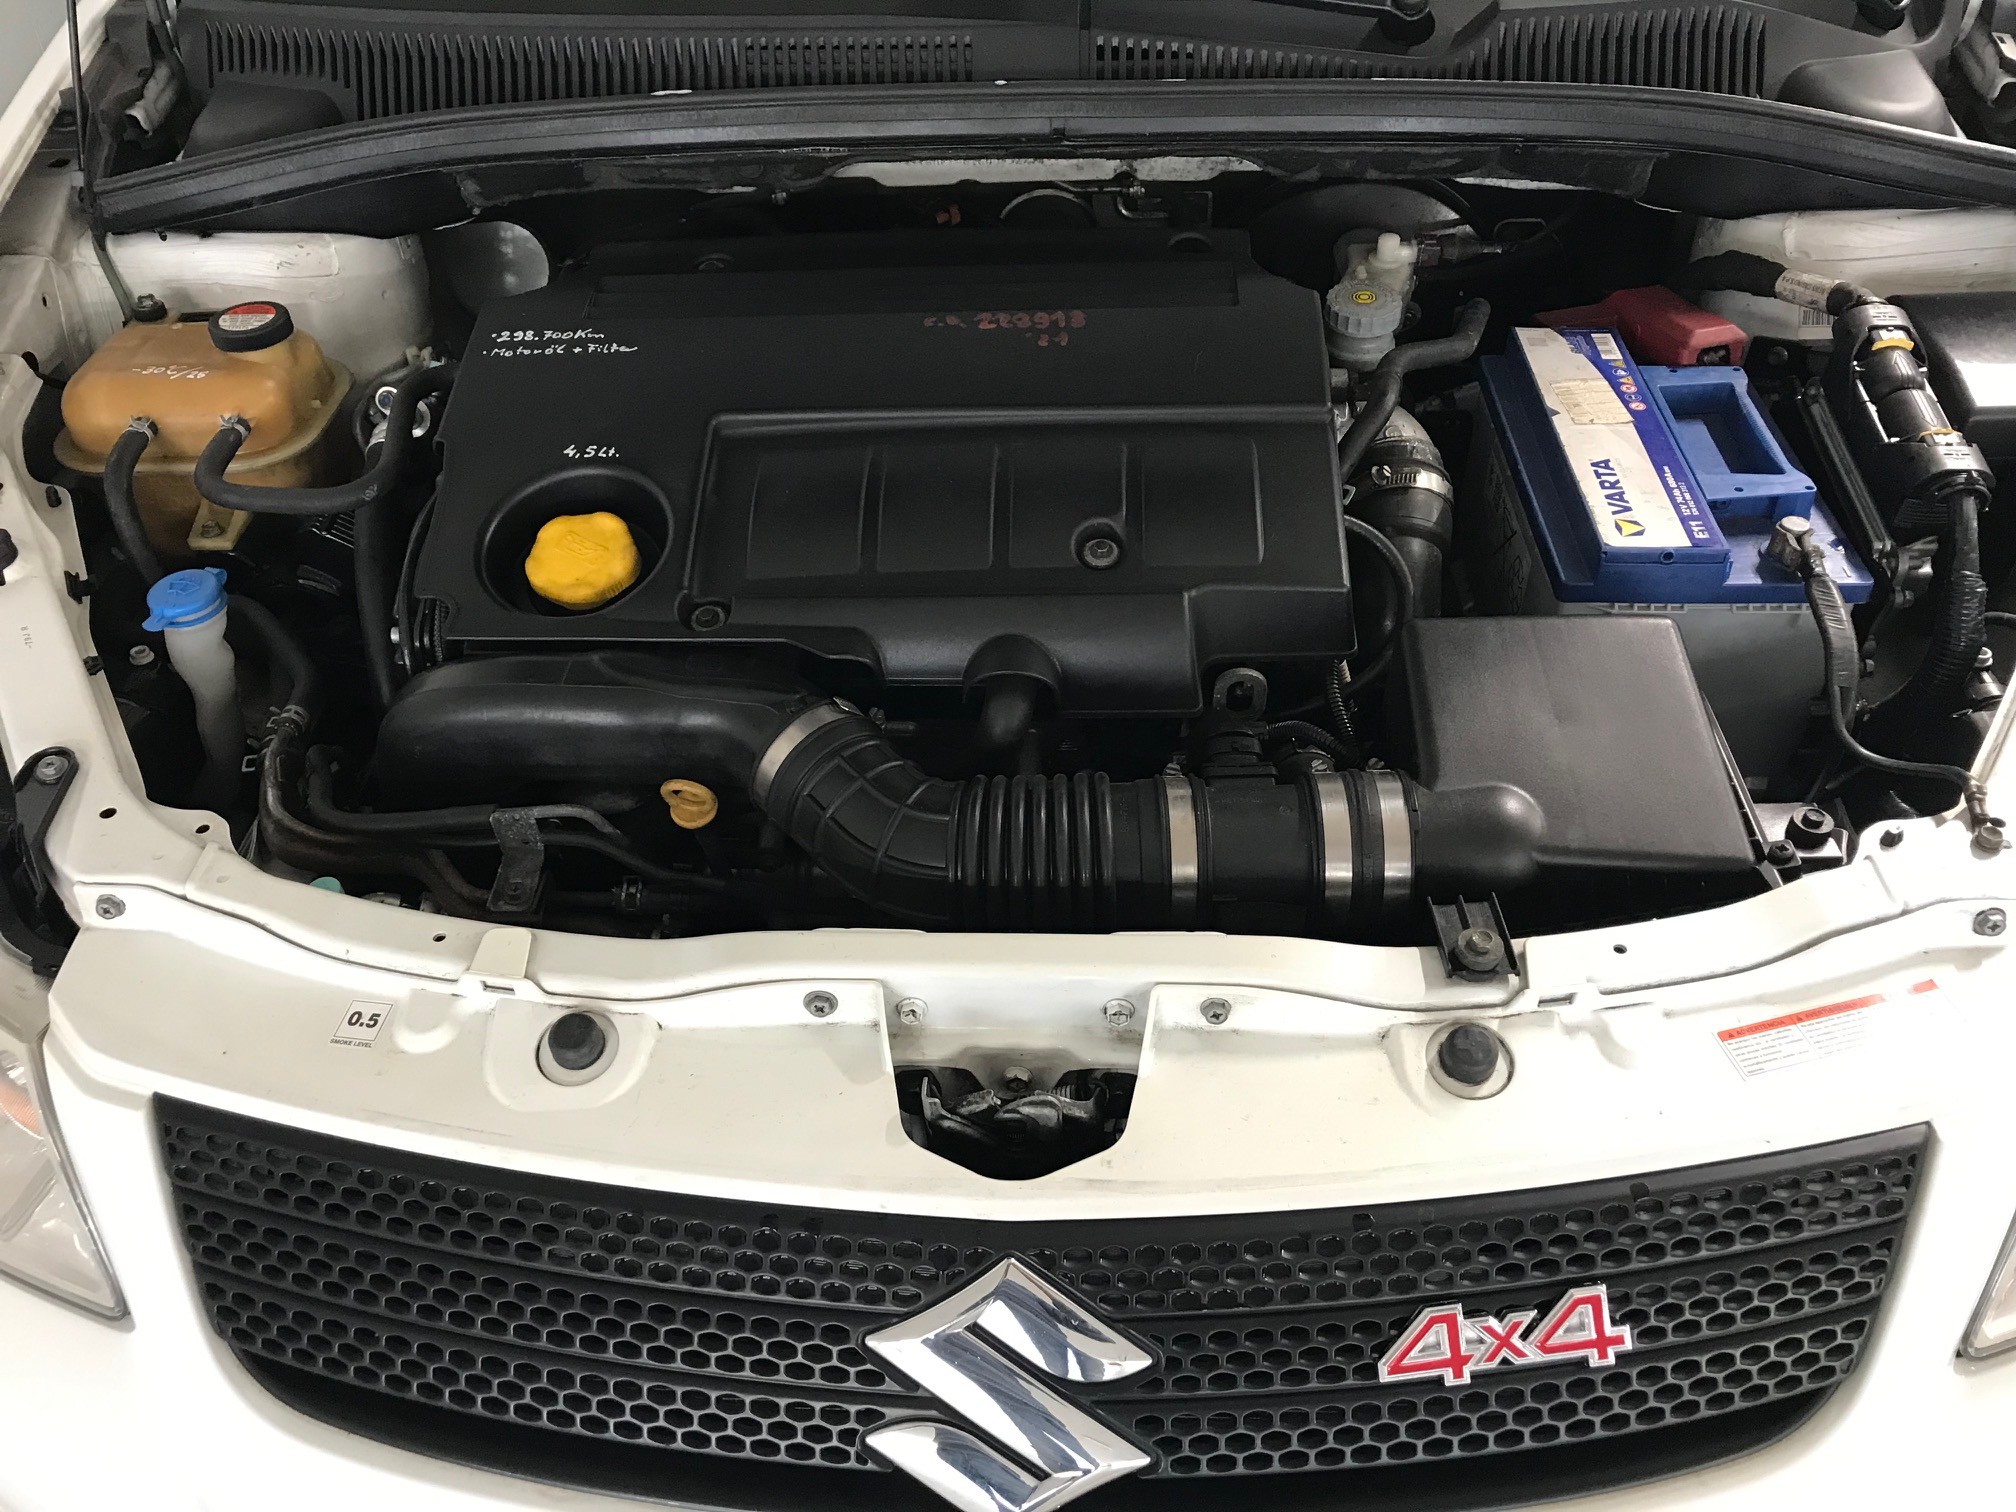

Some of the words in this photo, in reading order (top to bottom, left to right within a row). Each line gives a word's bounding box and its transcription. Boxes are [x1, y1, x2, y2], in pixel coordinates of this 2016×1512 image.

[1590, 458, 1633, 516] VARTA
[1688, 520, 1711, 539] E11
[346, 1010, 382, 1029] 0.5
[329, 1038, 354, 1047] SMOKE
[353, 1040, 373, 1049] LEVEL
[1378, 1284, 1633, 1387] 4x4
